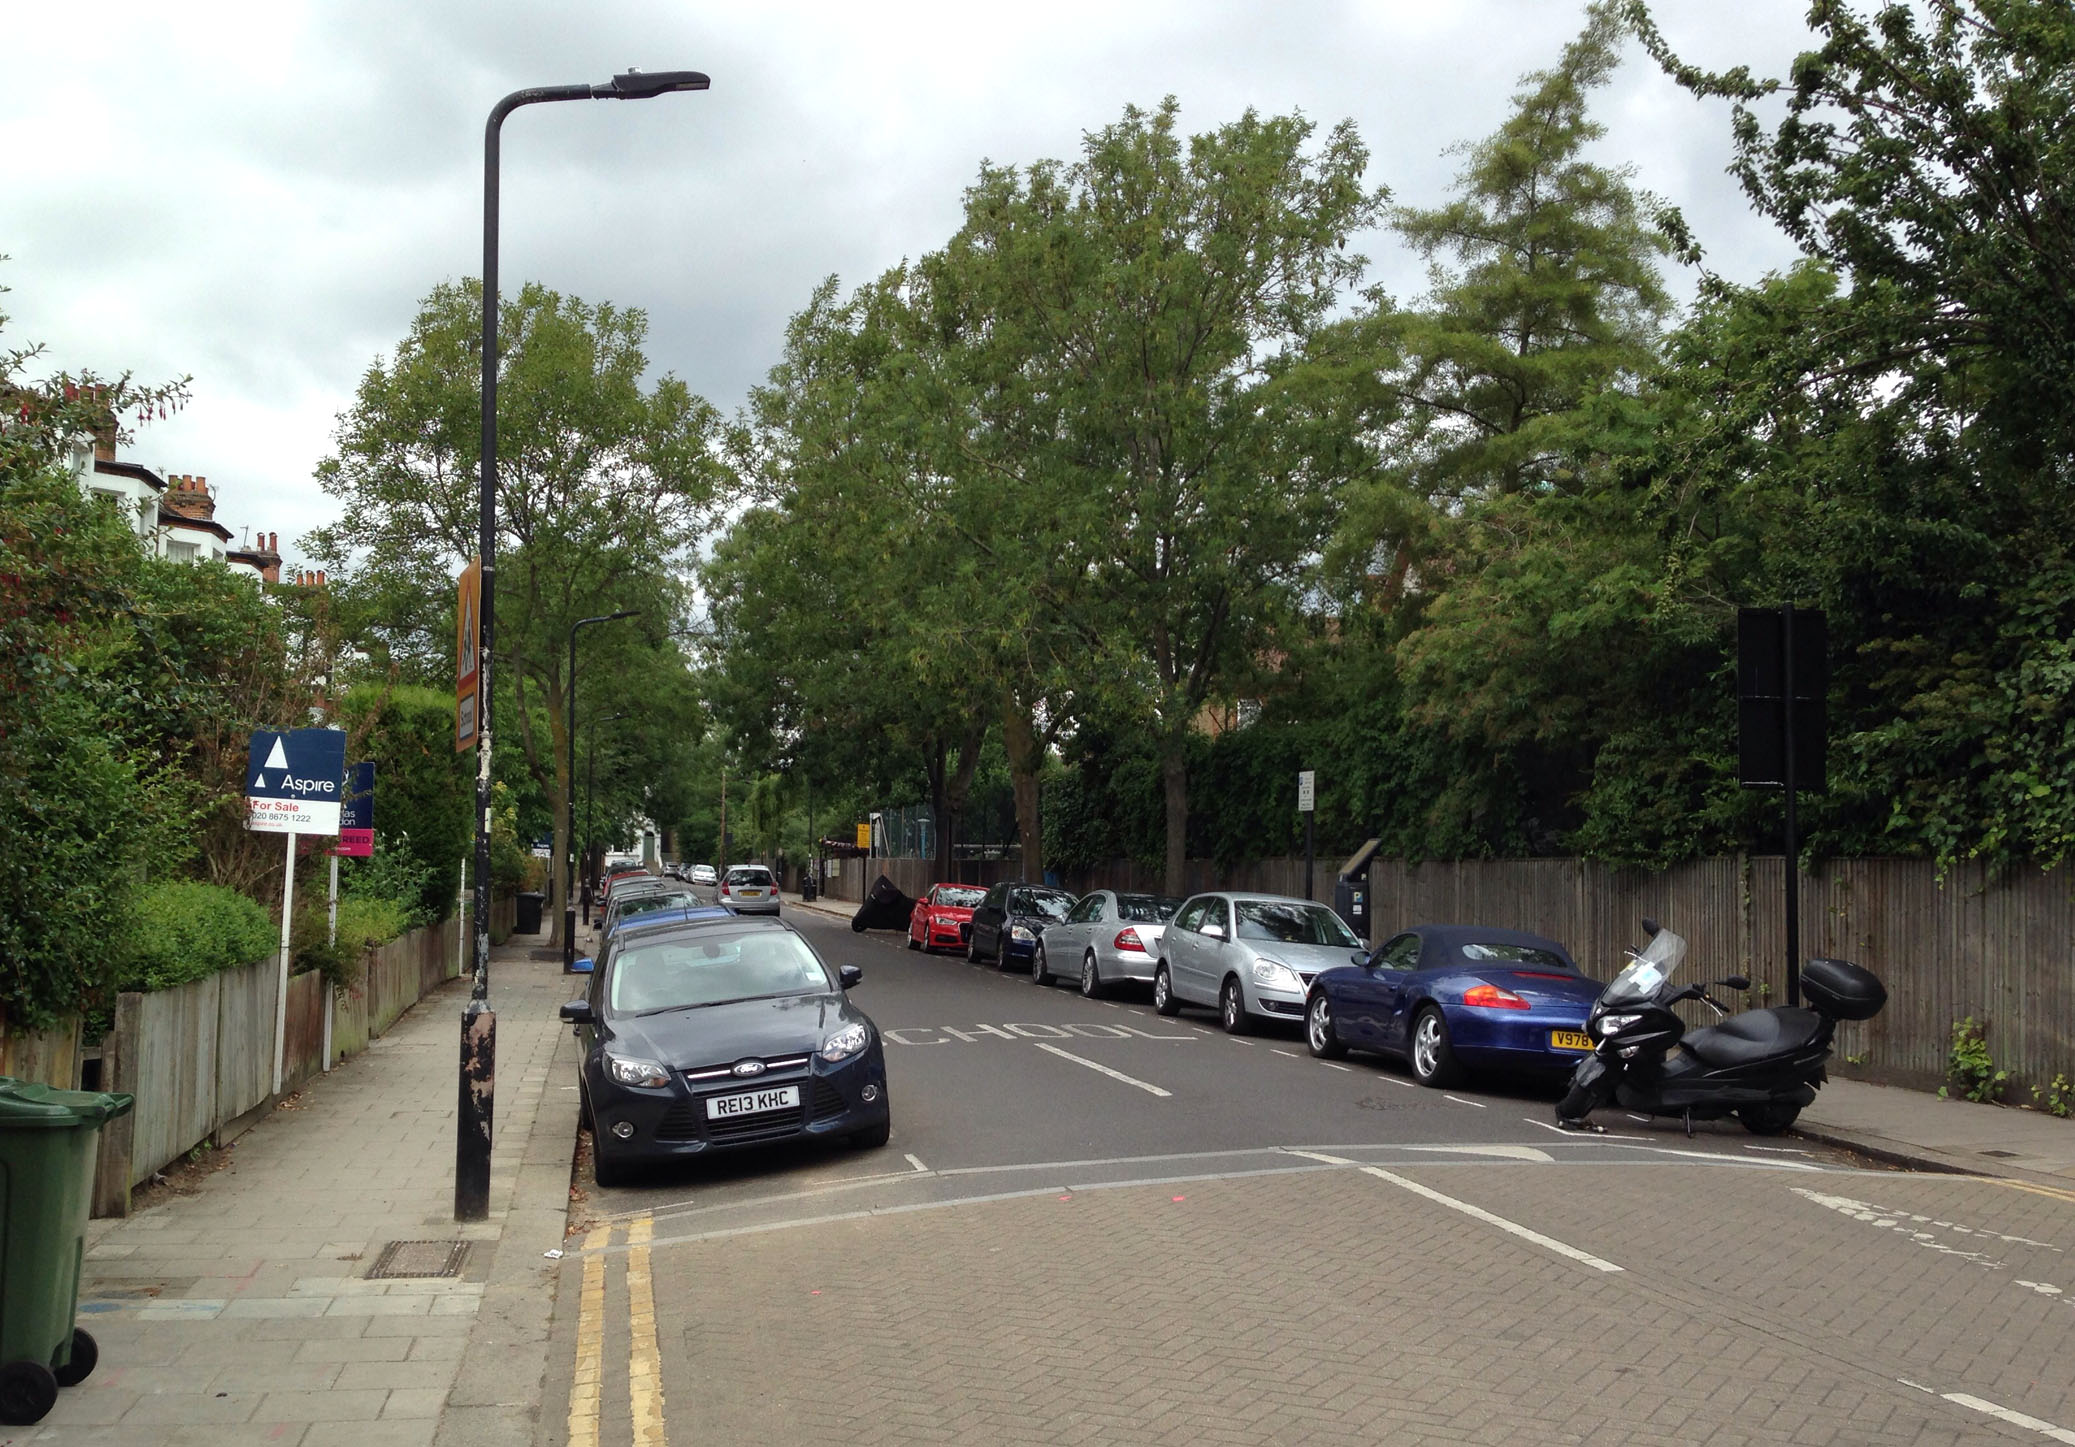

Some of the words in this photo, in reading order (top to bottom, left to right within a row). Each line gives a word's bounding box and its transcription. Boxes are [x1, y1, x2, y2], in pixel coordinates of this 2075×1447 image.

[281, 774, 335, 795] Aspire
[253, 800, 271, 810] For
[275, 801, 299, 812] Sale
[252, 811, 267, 820] 020
[269, 812, 289, 821] 8675
[291, 814, 312, 823] 1222
[339, 818, 356, 826] don
[342, 836, 370, 844] REED
[883, 1023, 1198, 1045] CHOOL
[1557, 1032, 1589, 1047] V978
[717, 1096, 753, 1115] RE13
[757, 1091, 789, 1109] KHC
